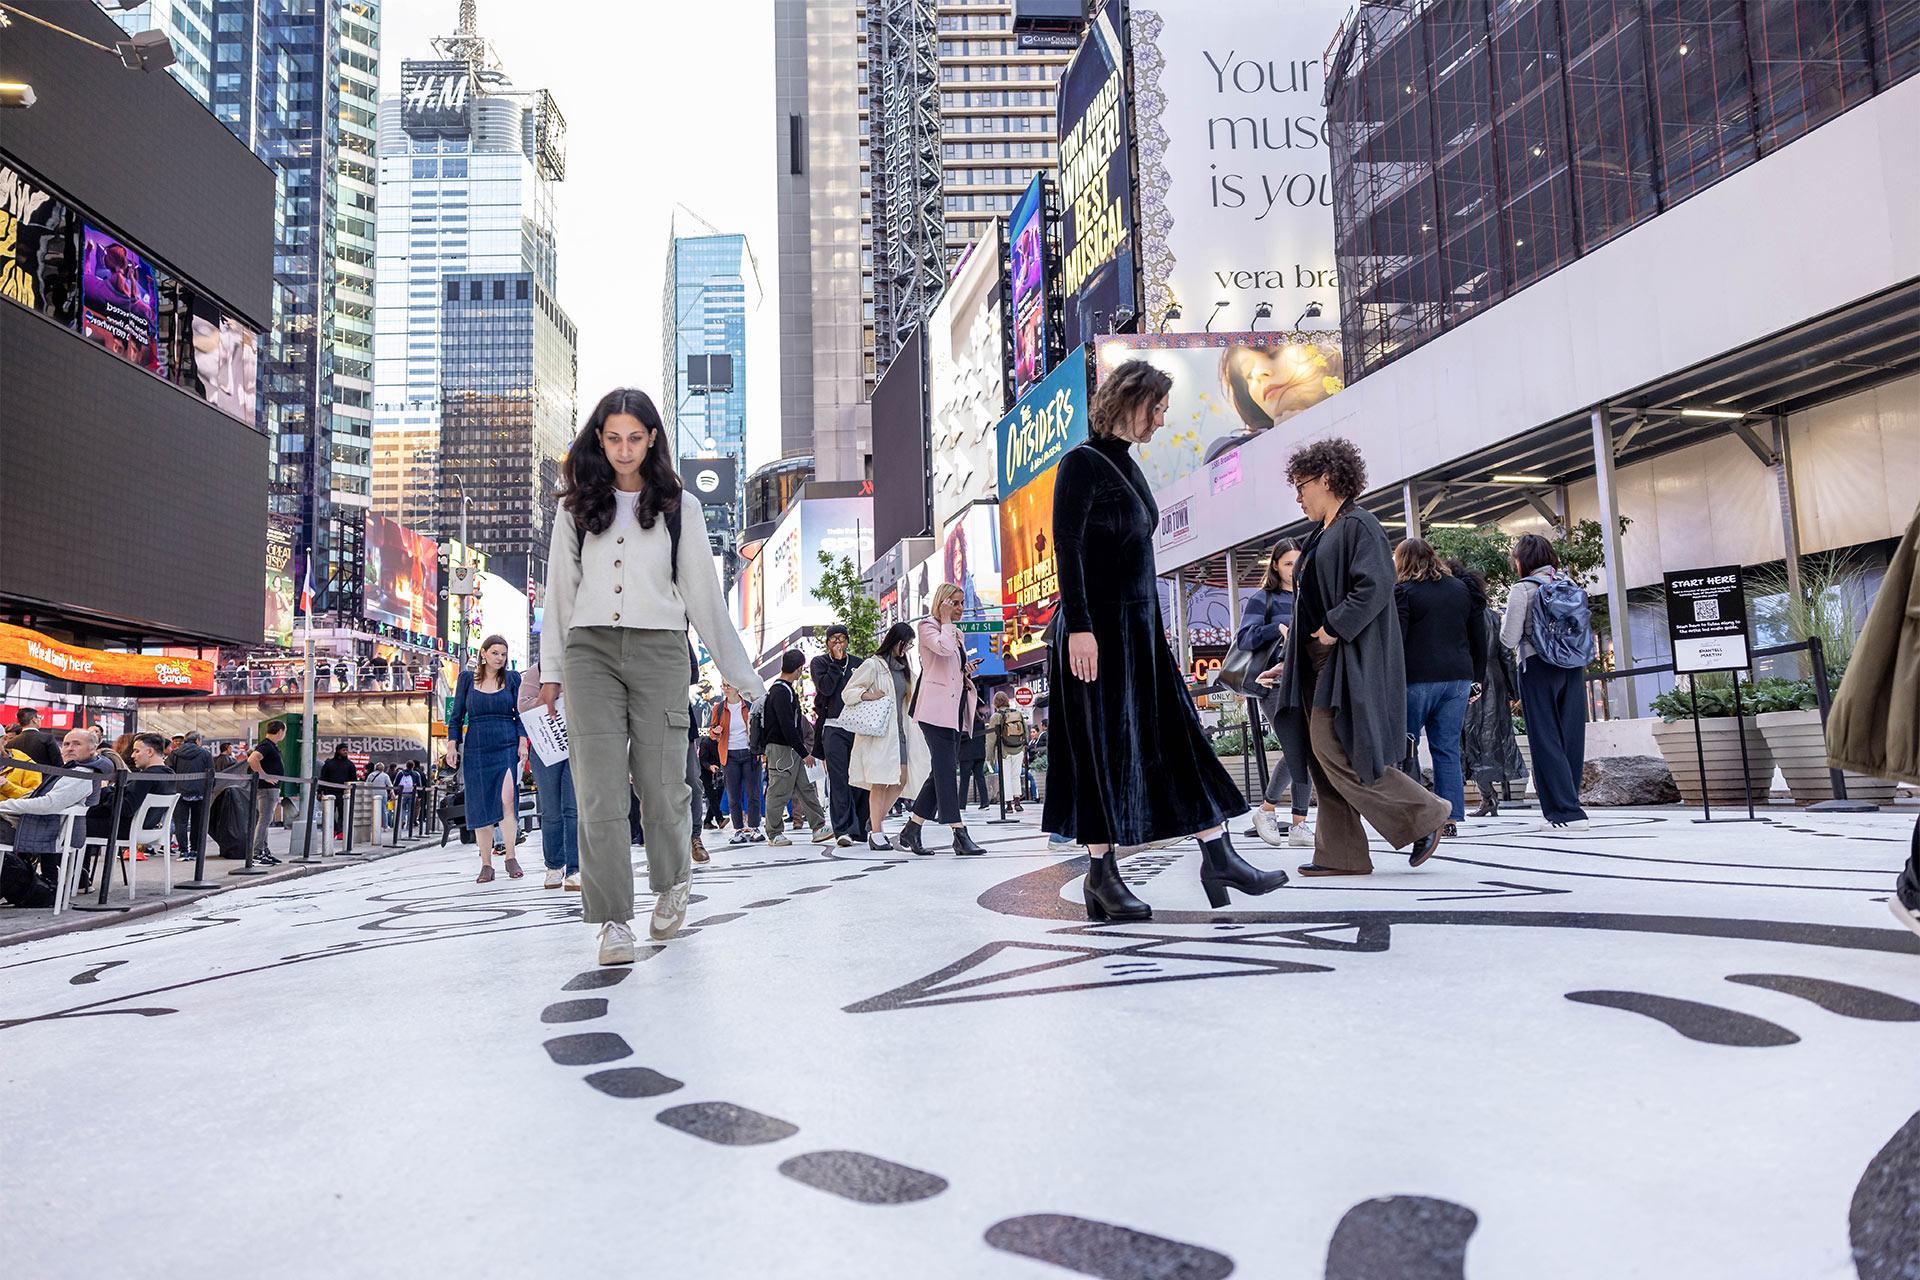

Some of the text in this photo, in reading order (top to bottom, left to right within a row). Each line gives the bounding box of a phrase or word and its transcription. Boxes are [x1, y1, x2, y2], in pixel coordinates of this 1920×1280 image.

[1202, 50, 1319, 93] Your
[406, 75, 469, 114] H&M
[1060, 68, 1119, 171] TONY AWARD
[883, 61, 899, 271] AMERICAN EAGLE
[898, 84, 913, 234] OUTFITTERS
[1060, 100, 1121, 213] WINNER!
[1075, 165, 1110, 241] BEST
[1210, 163, 1246, 208] is
[1064, 196, 1127, 300] MUSICAL
[1214, 270, 1284, 289] vera
[1006, 388, 1074, 485] OUTSIDERS
[1161, 514, 1173, 536] OUR
[1172, 506, 1189, 531] TOWN
[1671, 574, 1736, 589] START HERE
[971, 623, 980, 631] 47
[1211, 693, 1231, 701] ONLY
